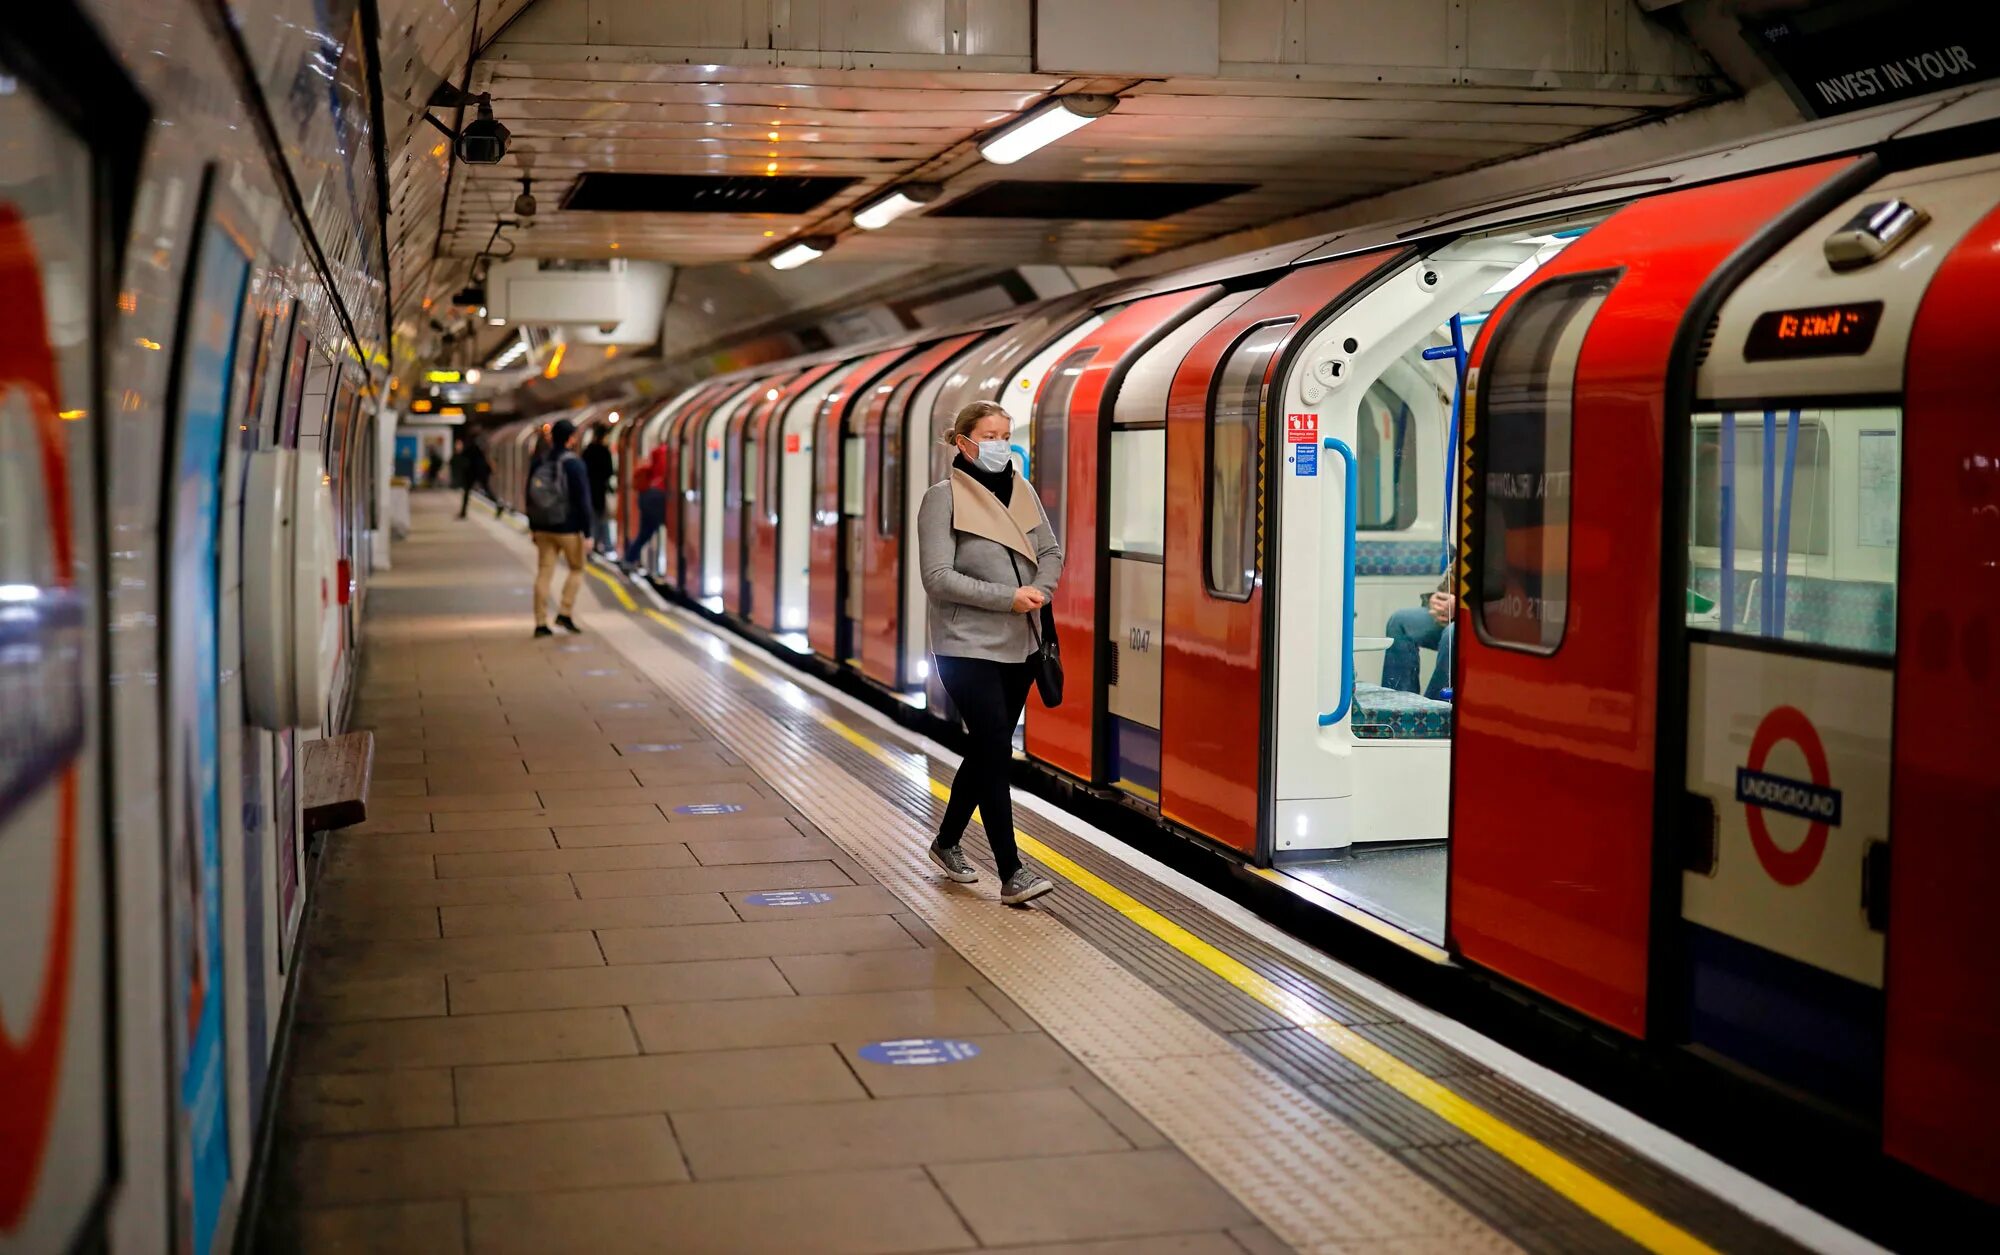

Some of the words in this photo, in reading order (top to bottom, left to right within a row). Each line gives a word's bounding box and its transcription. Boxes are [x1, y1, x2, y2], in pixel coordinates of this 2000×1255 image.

[1816, 68, 1885, 104] INVEST
[1881, 61, 1912, 88] IN
[1906, 45, 1976, 81] YOUR
[1129, 627, 1150, 653] 12047
[1741, 775, 1835, 816] UNDERGROUND
